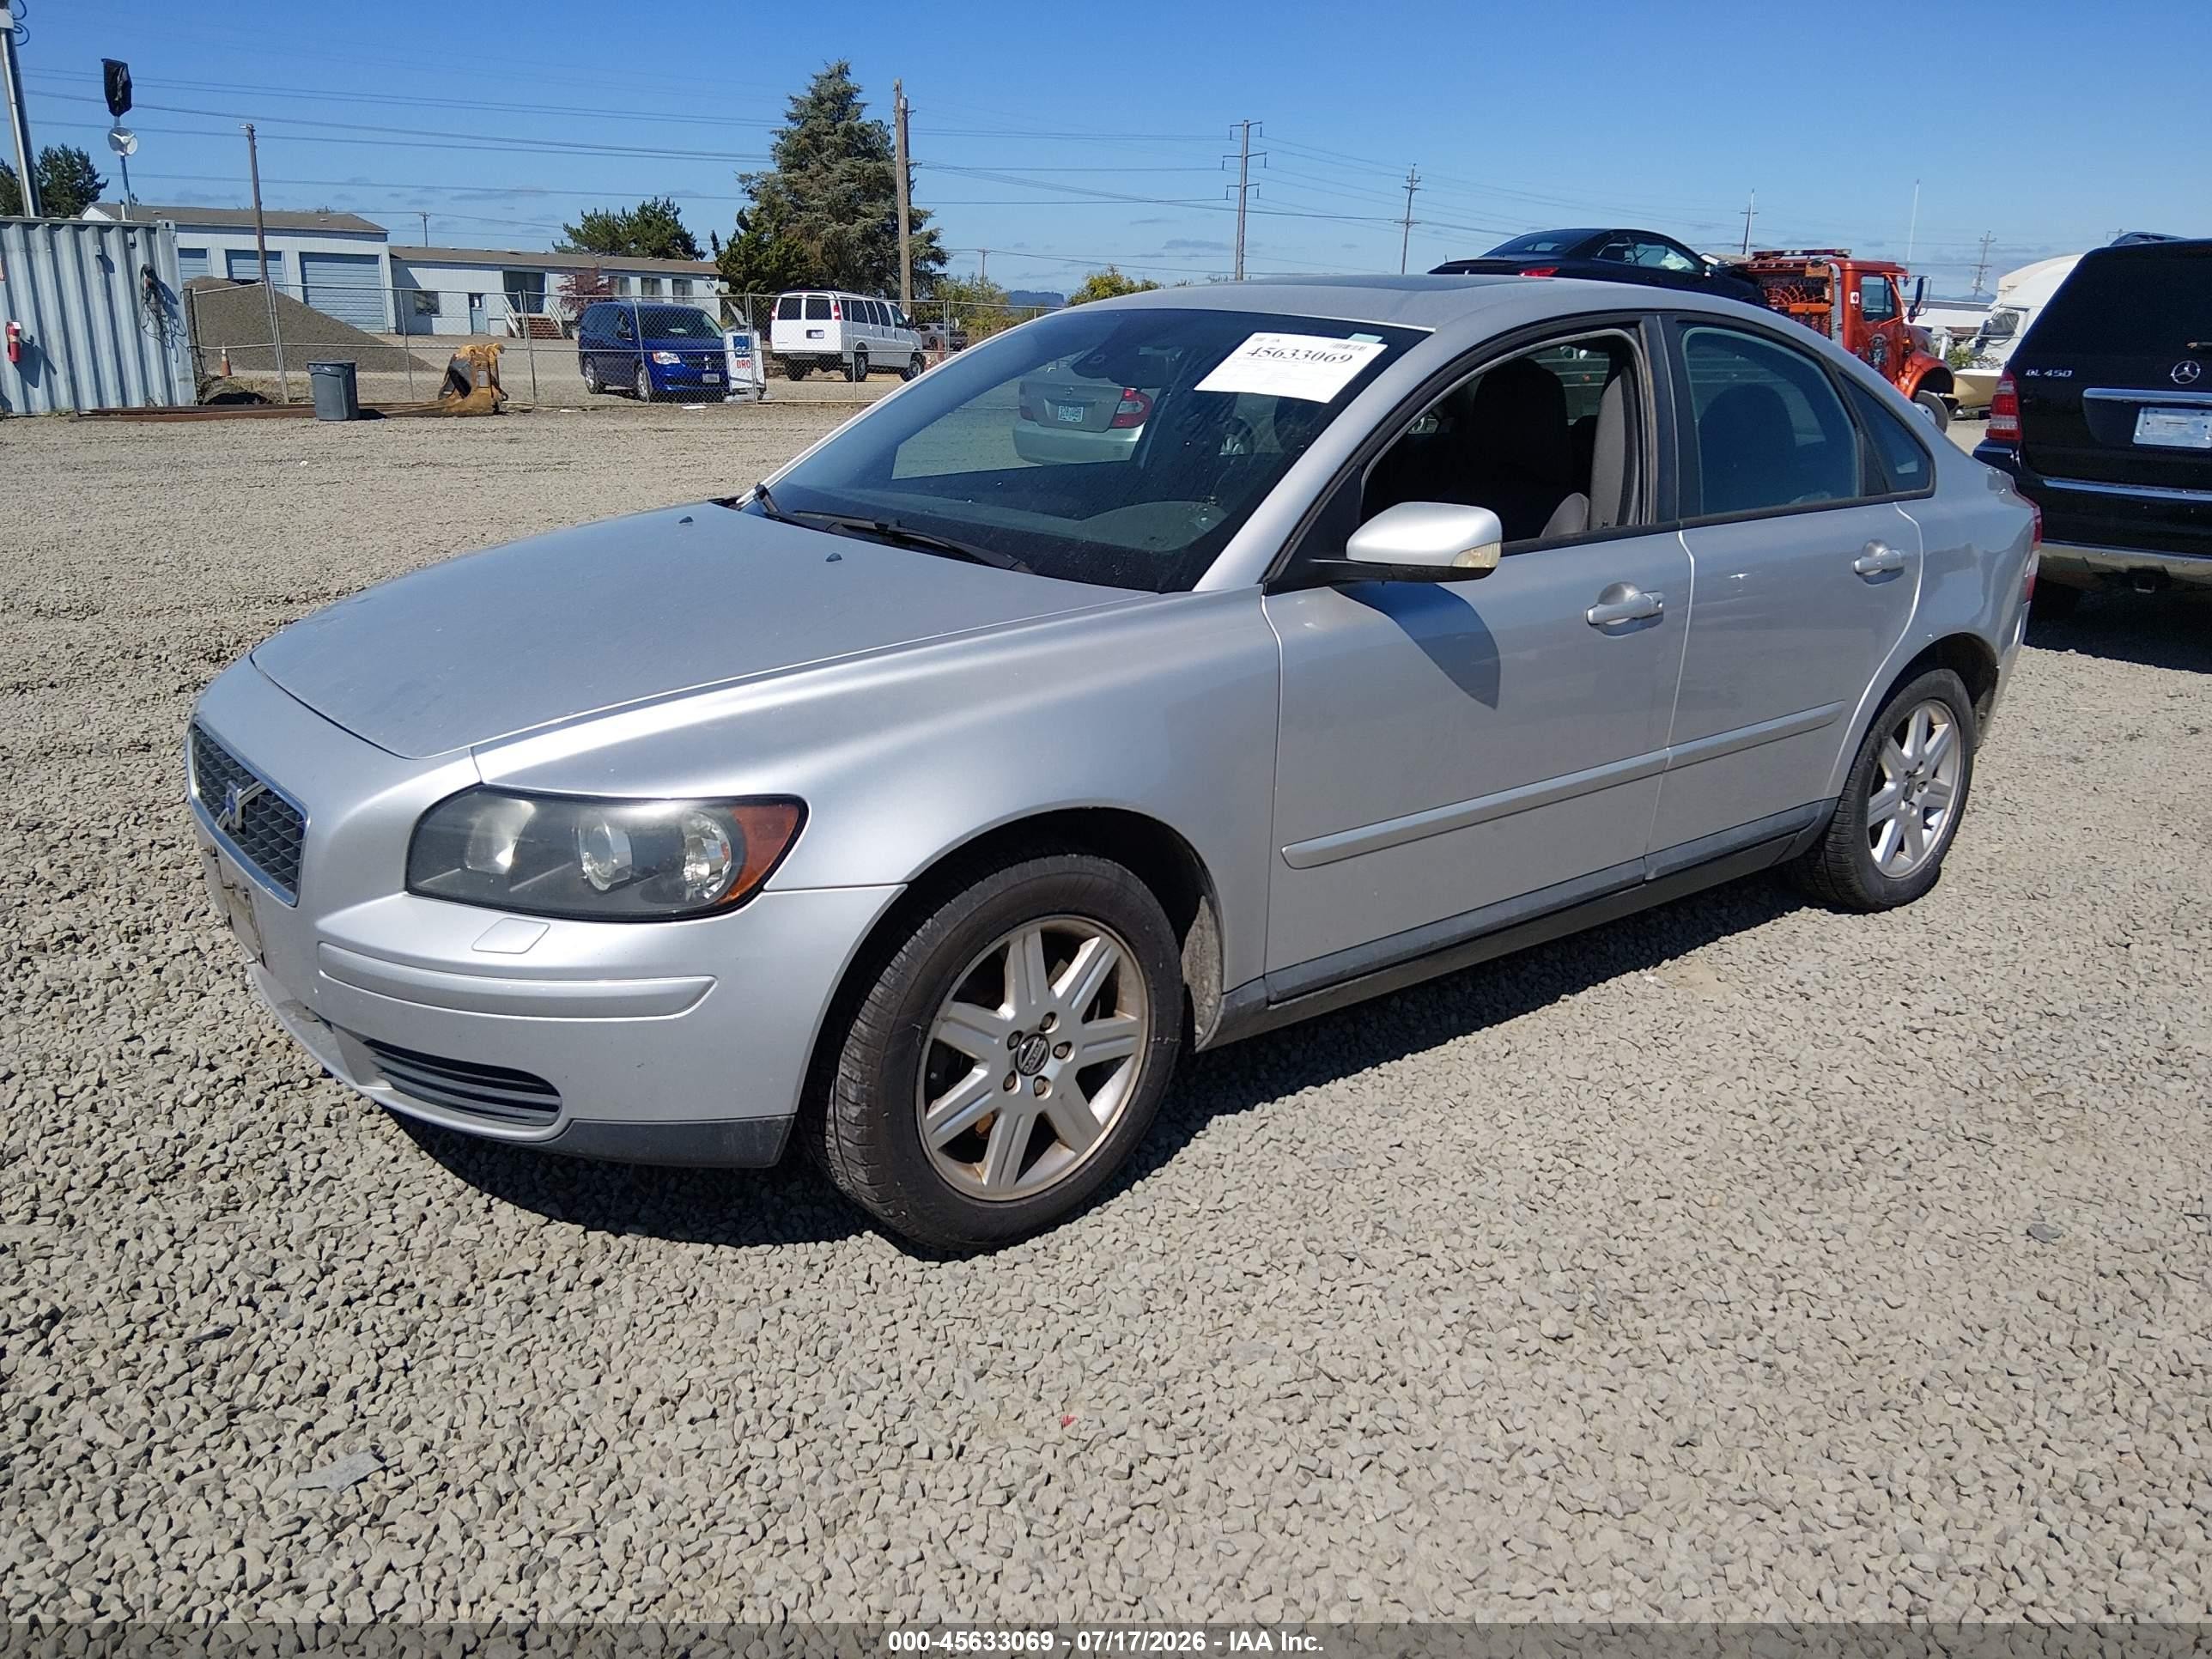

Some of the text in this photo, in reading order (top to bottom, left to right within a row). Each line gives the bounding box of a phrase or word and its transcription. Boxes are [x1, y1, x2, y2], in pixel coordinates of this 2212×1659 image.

[735, 345, 752, 356] GS
[1247, 346, 1354, 364] 45633069
[2044, 369, 2073, 378] 450
